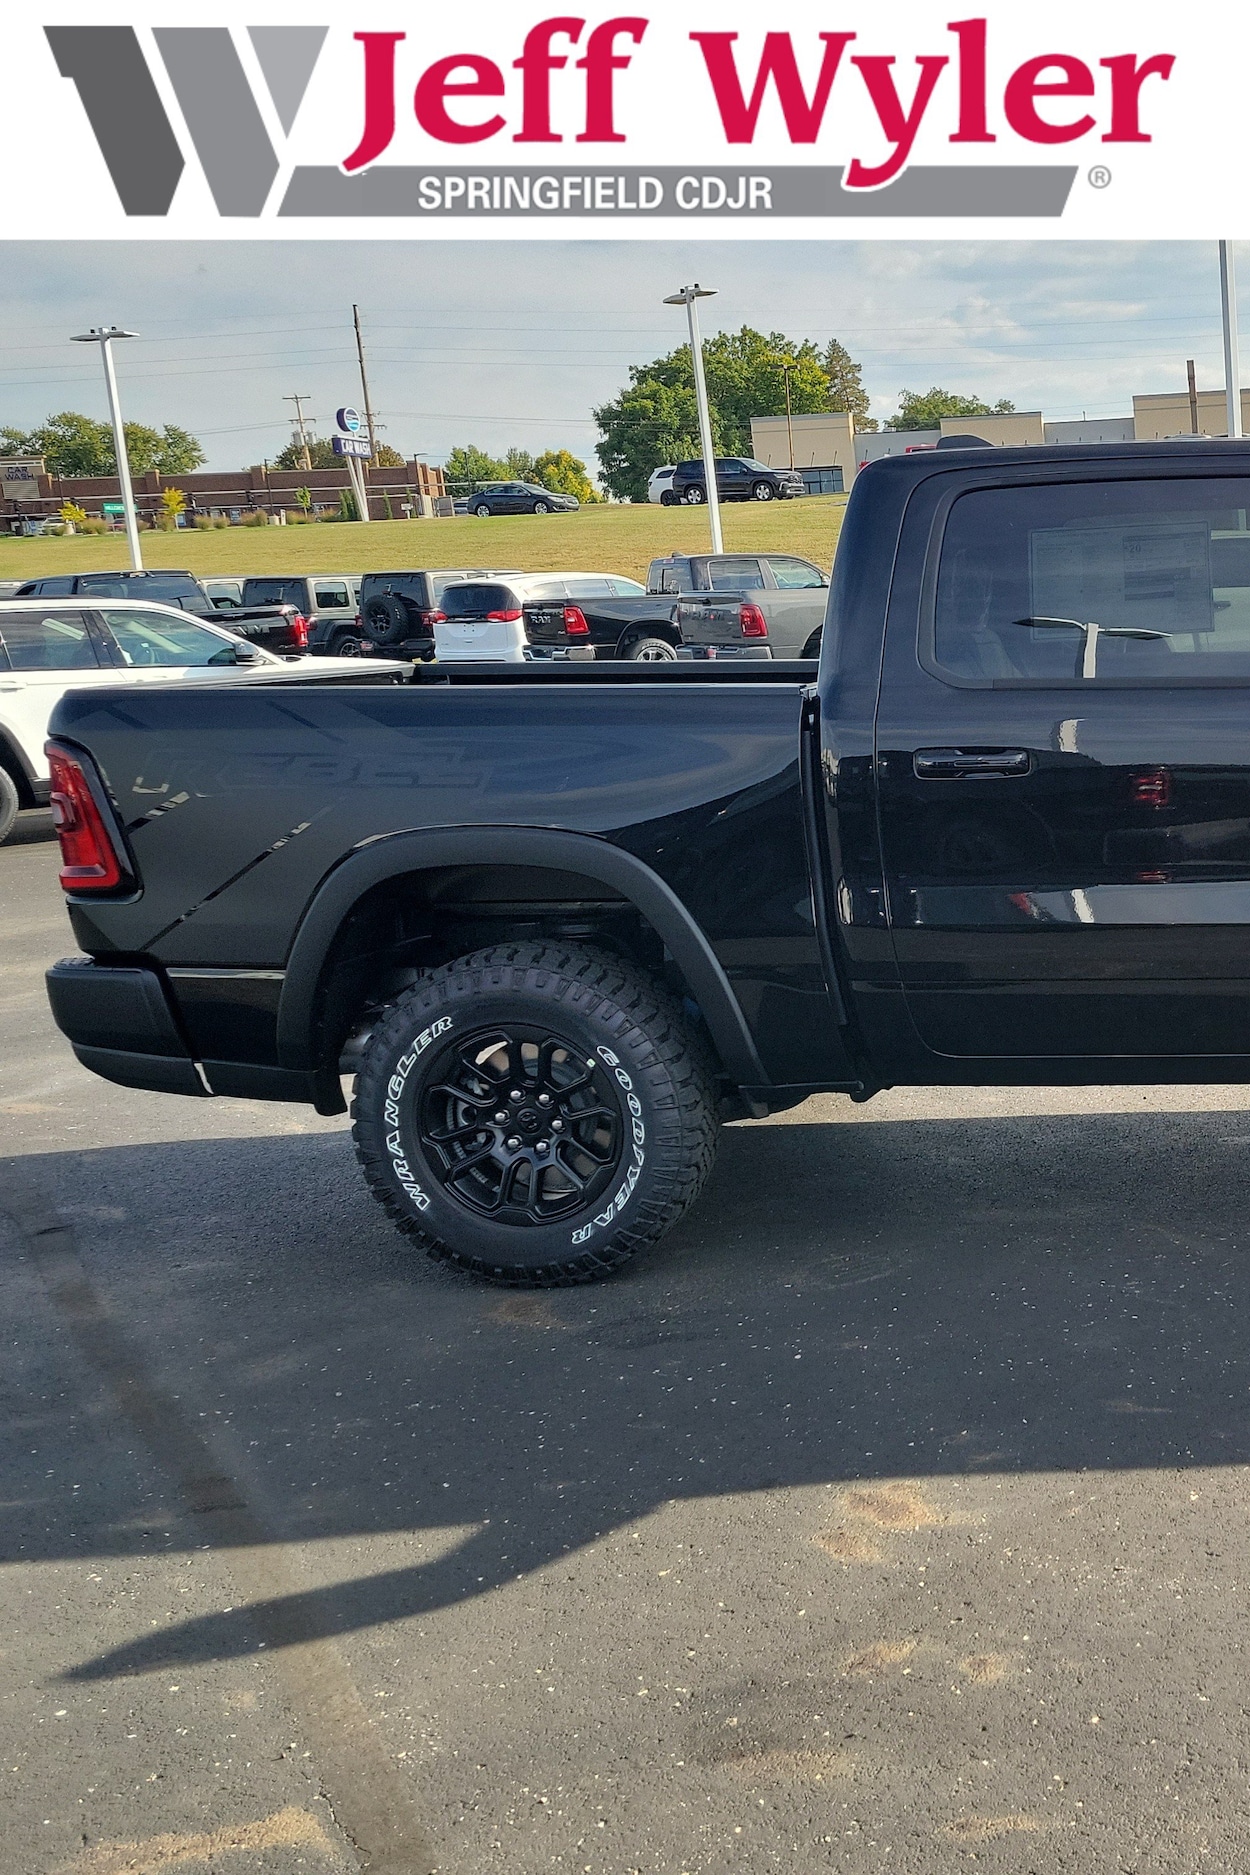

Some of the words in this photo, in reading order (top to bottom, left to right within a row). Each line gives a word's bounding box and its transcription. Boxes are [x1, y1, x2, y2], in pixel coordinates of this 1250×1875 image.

[341, 440, 354, 454] CAR
[354, 441, 371, 456] WASH
[383, 1016, 453, 1211] WRANGLER
[571, 1045, 645, 1245] GOODYEAR
